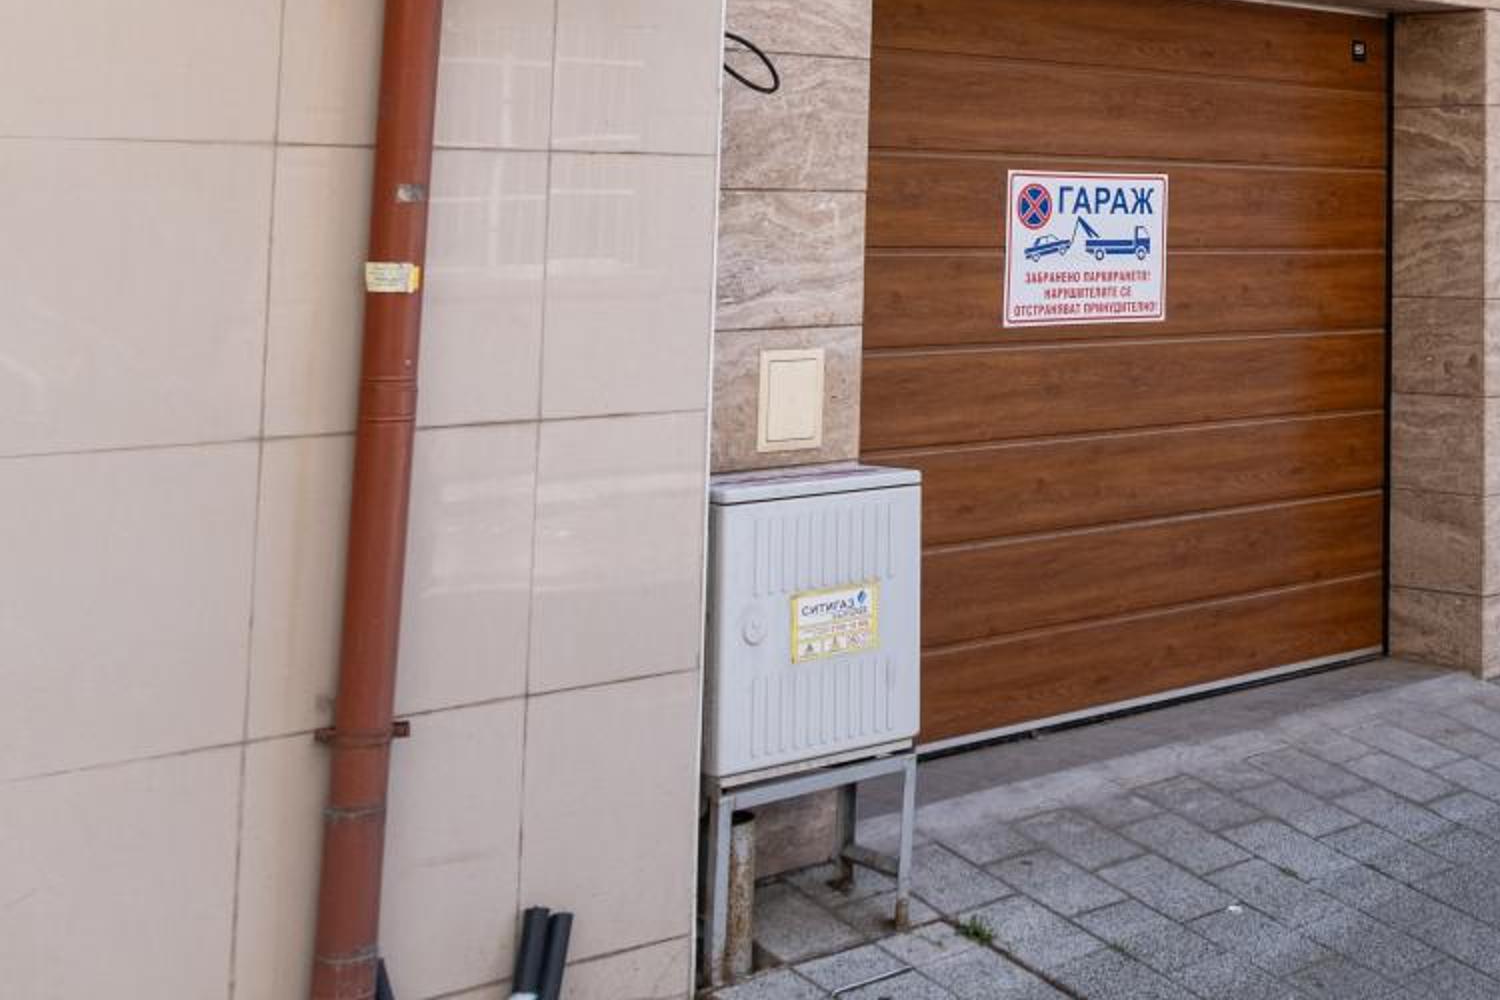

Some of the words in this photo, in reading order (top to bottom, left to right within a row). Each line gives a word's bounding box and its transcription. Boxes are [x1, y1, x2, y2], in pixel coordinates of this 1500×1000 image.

[1057, 185, 1154, 215] ГАРАЖ
[1024, 271, 1080, 283] ЗАБРАНЕНО
[1043, 287, 1116, 299] НАРУШИТЕЛИТЕ
[1119, 286, 1131, 297] СЕ
[801, 599, 855, 616] СИТИГАЗ
